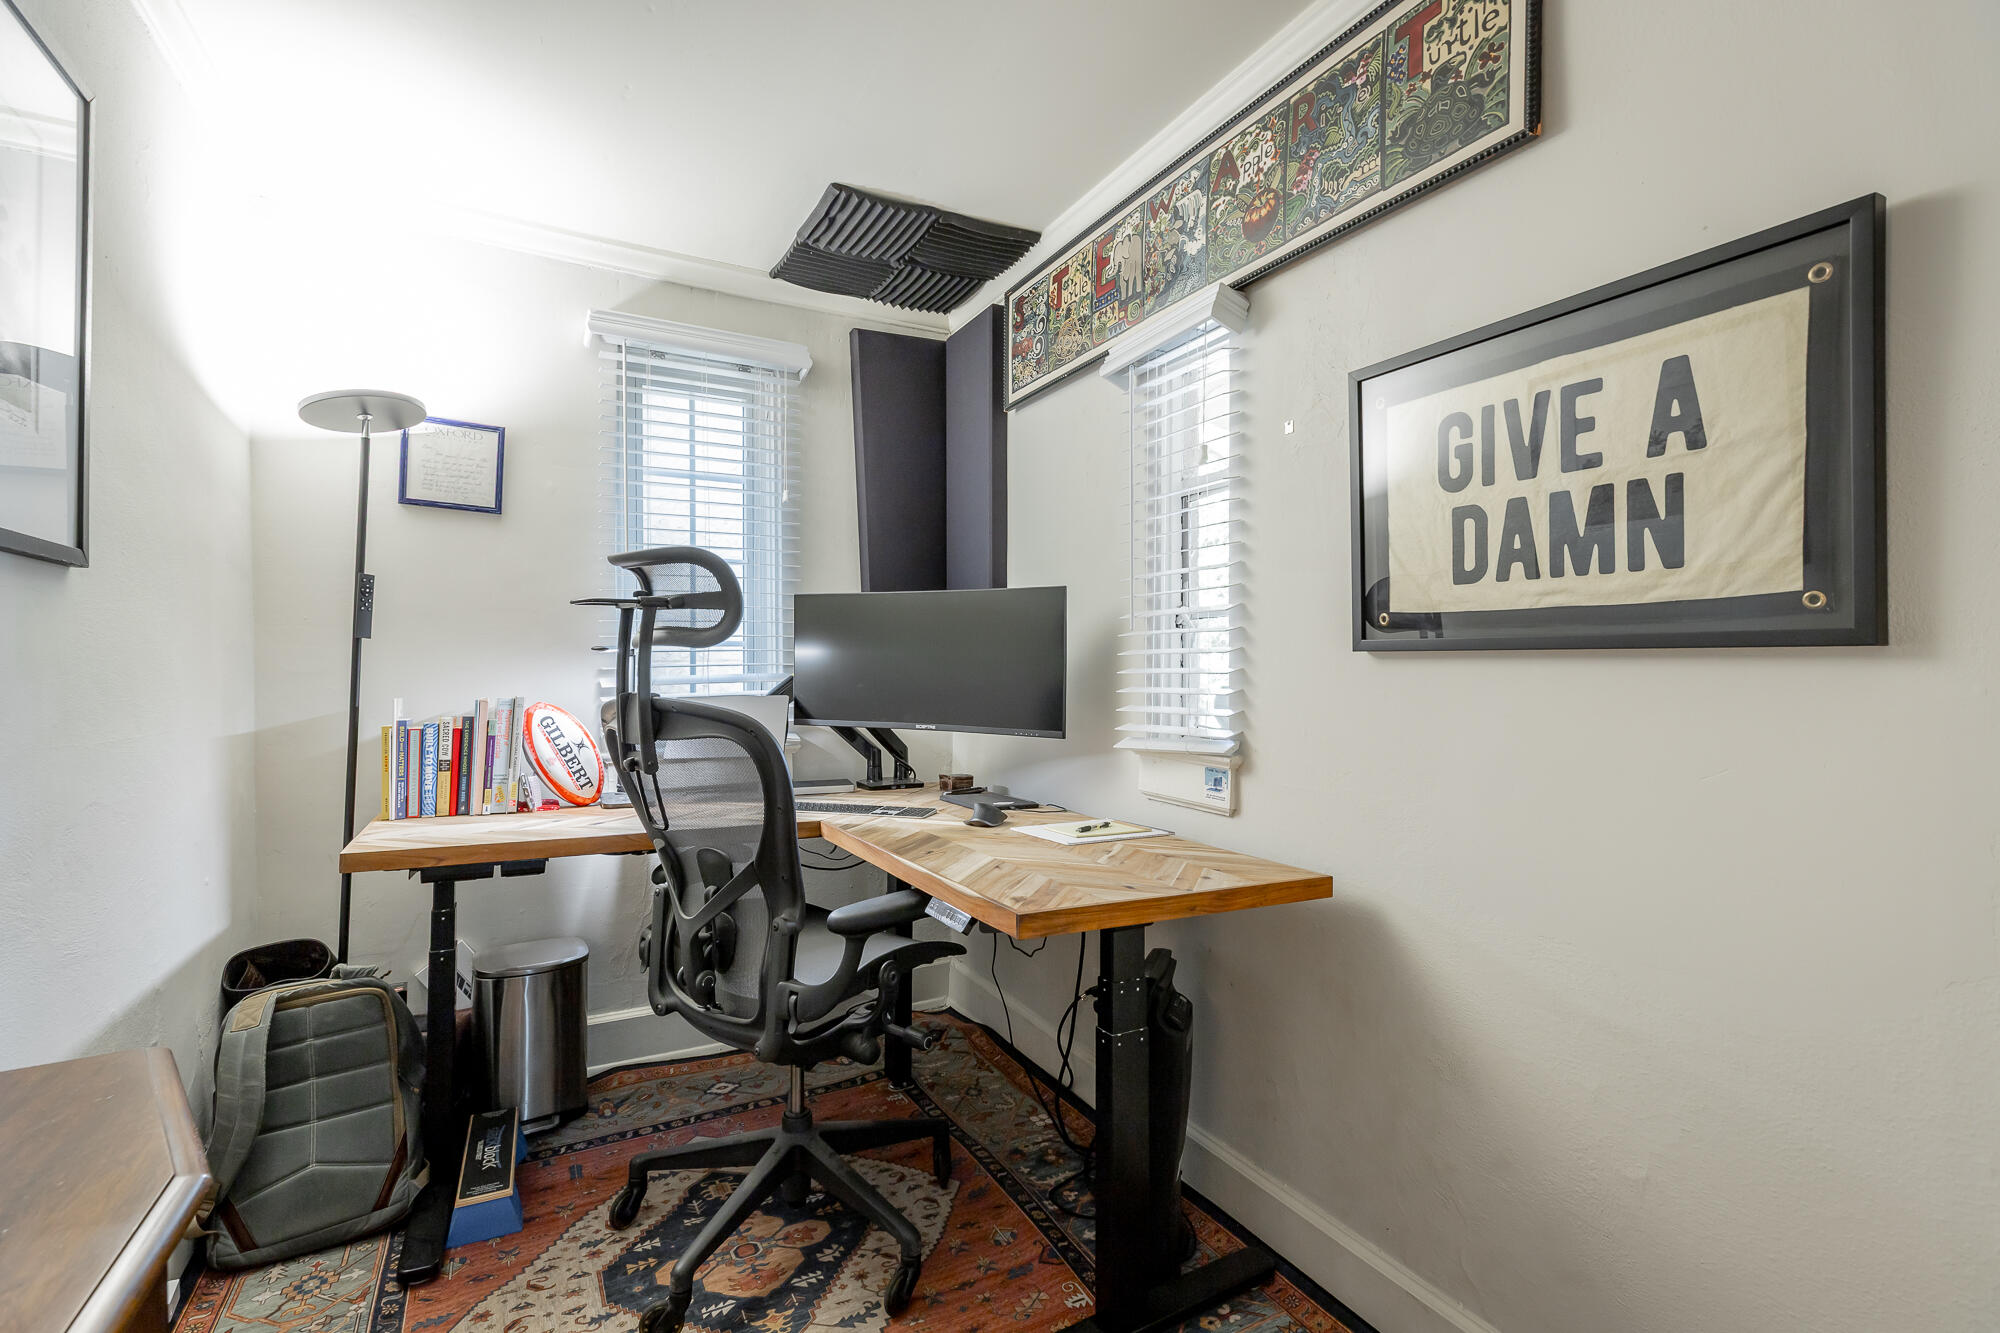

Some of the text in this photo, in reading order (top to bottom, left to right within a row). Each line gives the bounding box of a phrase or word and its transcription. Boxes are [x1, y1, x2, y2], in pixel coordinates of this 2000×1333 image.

[1394, 0, 1500, 80] Turtle
[1211, 144, 1274, 193] Apple
[1052, 264, 1088, 310] Turtle
[1437, 354, 1707, 493] GIVE A
[1452, 473, 1685, 585] DAMN
[425, 727, 434, 751] BUILT
[441, 743, 449, 757] COW
[442, 721, 450, 743] SACRED
[540, 715, 594, 790] GILBERT
[425, 753, 433, 764] TO
[425, 766, 433, 791] MOVE
